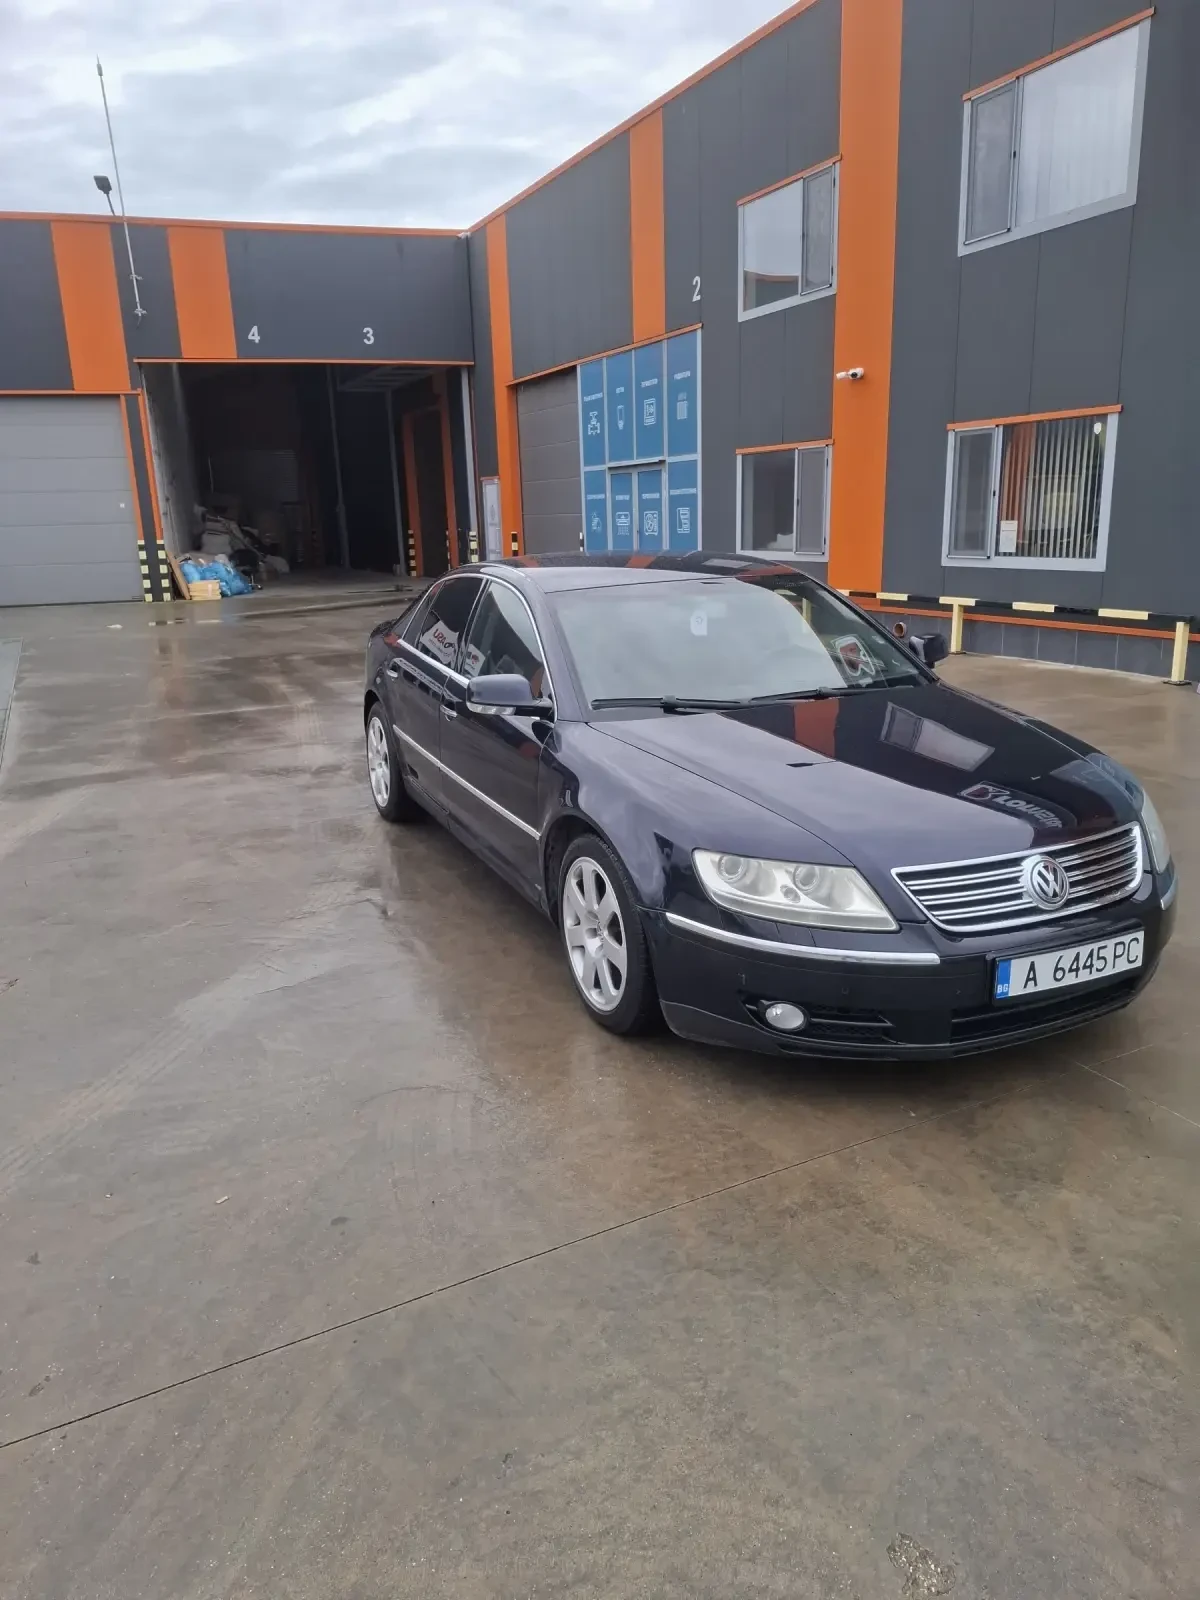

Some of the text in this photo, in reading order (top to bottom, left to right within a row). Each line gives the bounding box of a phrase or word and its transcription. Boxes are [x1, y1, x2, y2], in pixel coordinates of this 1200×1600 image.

[692, 275, 701, 302] 2
[247, 325, 261, 344] 4
[362, 327, 375, 345] 3
[1023, 960, 1038, 989] A
[996, 983, 1009, 994] BG
